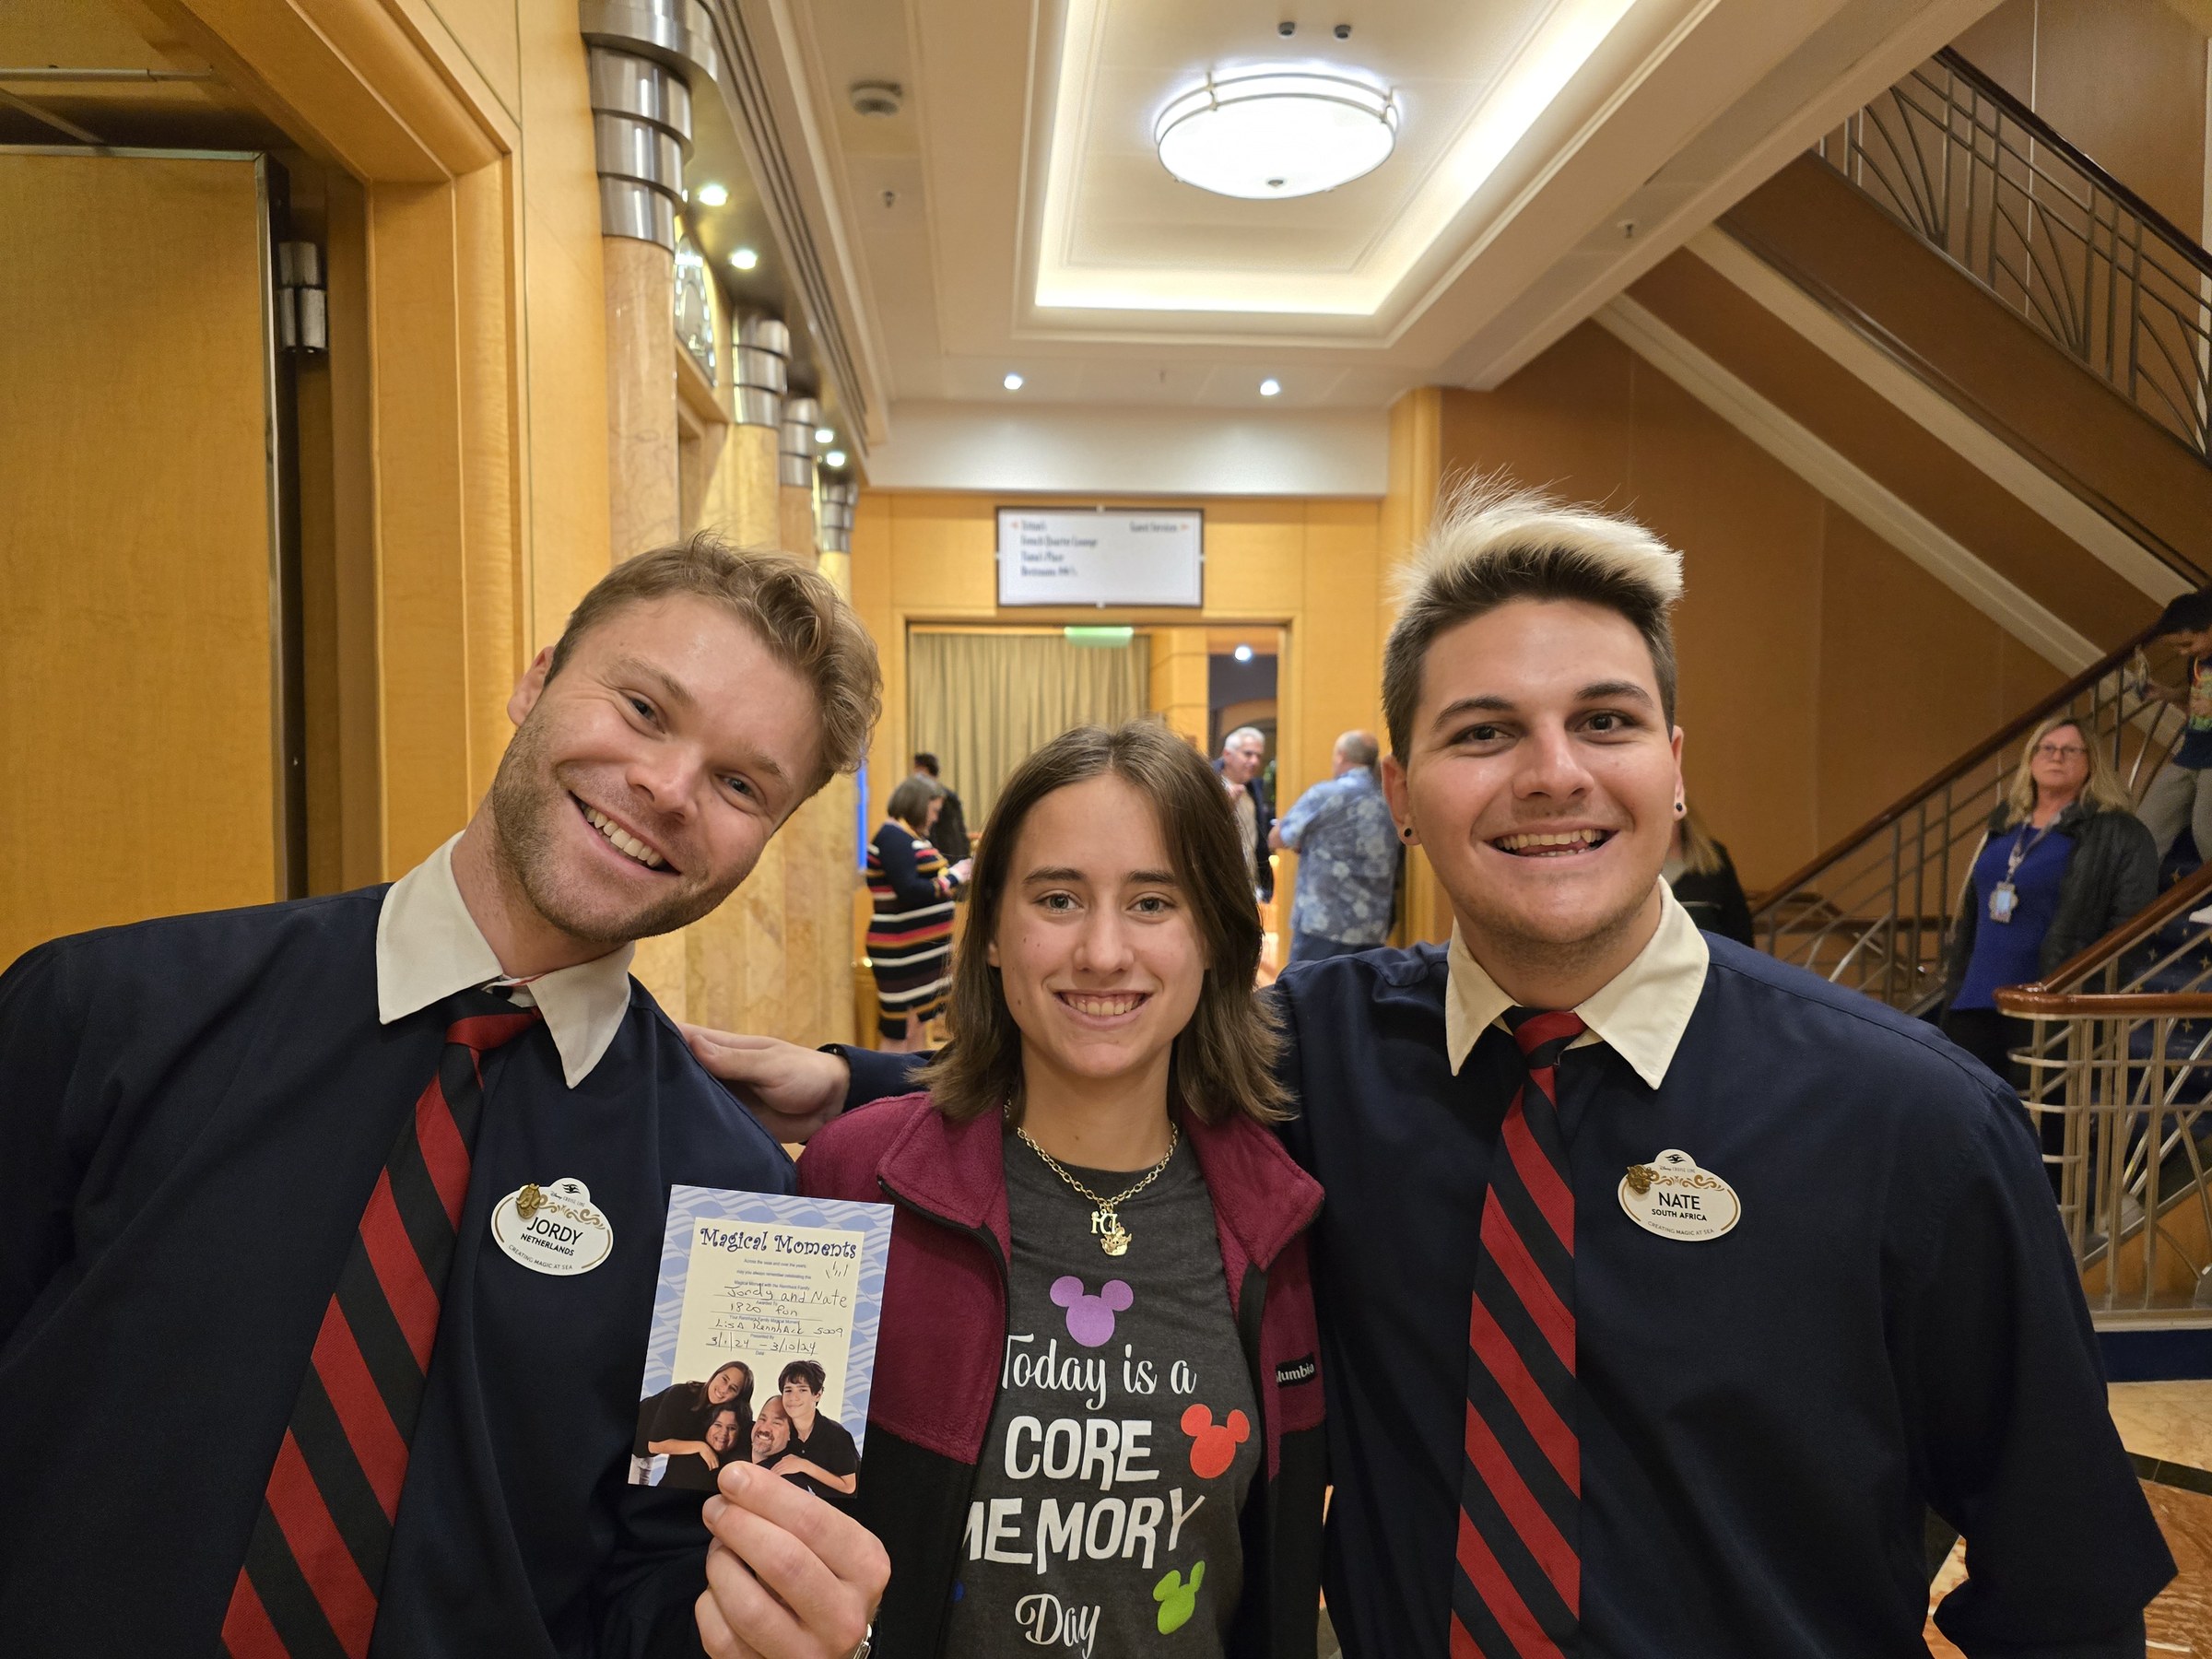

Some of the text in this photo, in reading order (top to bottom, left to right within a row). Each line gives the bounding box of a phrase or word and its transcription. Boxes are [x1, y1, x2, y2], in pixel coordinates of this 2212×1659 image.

[1658, 1192, 1700, 1210] NATE
[1652, 1208, 1707, 1221] SOUTH AFRICA
[527, 1217, 583, 1245] JORDY
[1648, 1221, 1675, 1234] CREATING
[520, 1233, 575, 1256] NETHERLANDS
[700, 1228, 857, 1259] Magical Moments
[509, 1244, 534, 1263] CREATING
[534, 1260, 552, 1269] MAGIC
[724, 1283, 848, 1308] Jordy and Nate
[771, 1337, 817, 1356] 3/10/24
[1002, 1334, 1197, 1410] Today is a
[1276, 1362, 1315, 1382] lumbia
[1004, 1415, 1160, 1491] CORE
[1015, 1593, 1101, 1659] Day
